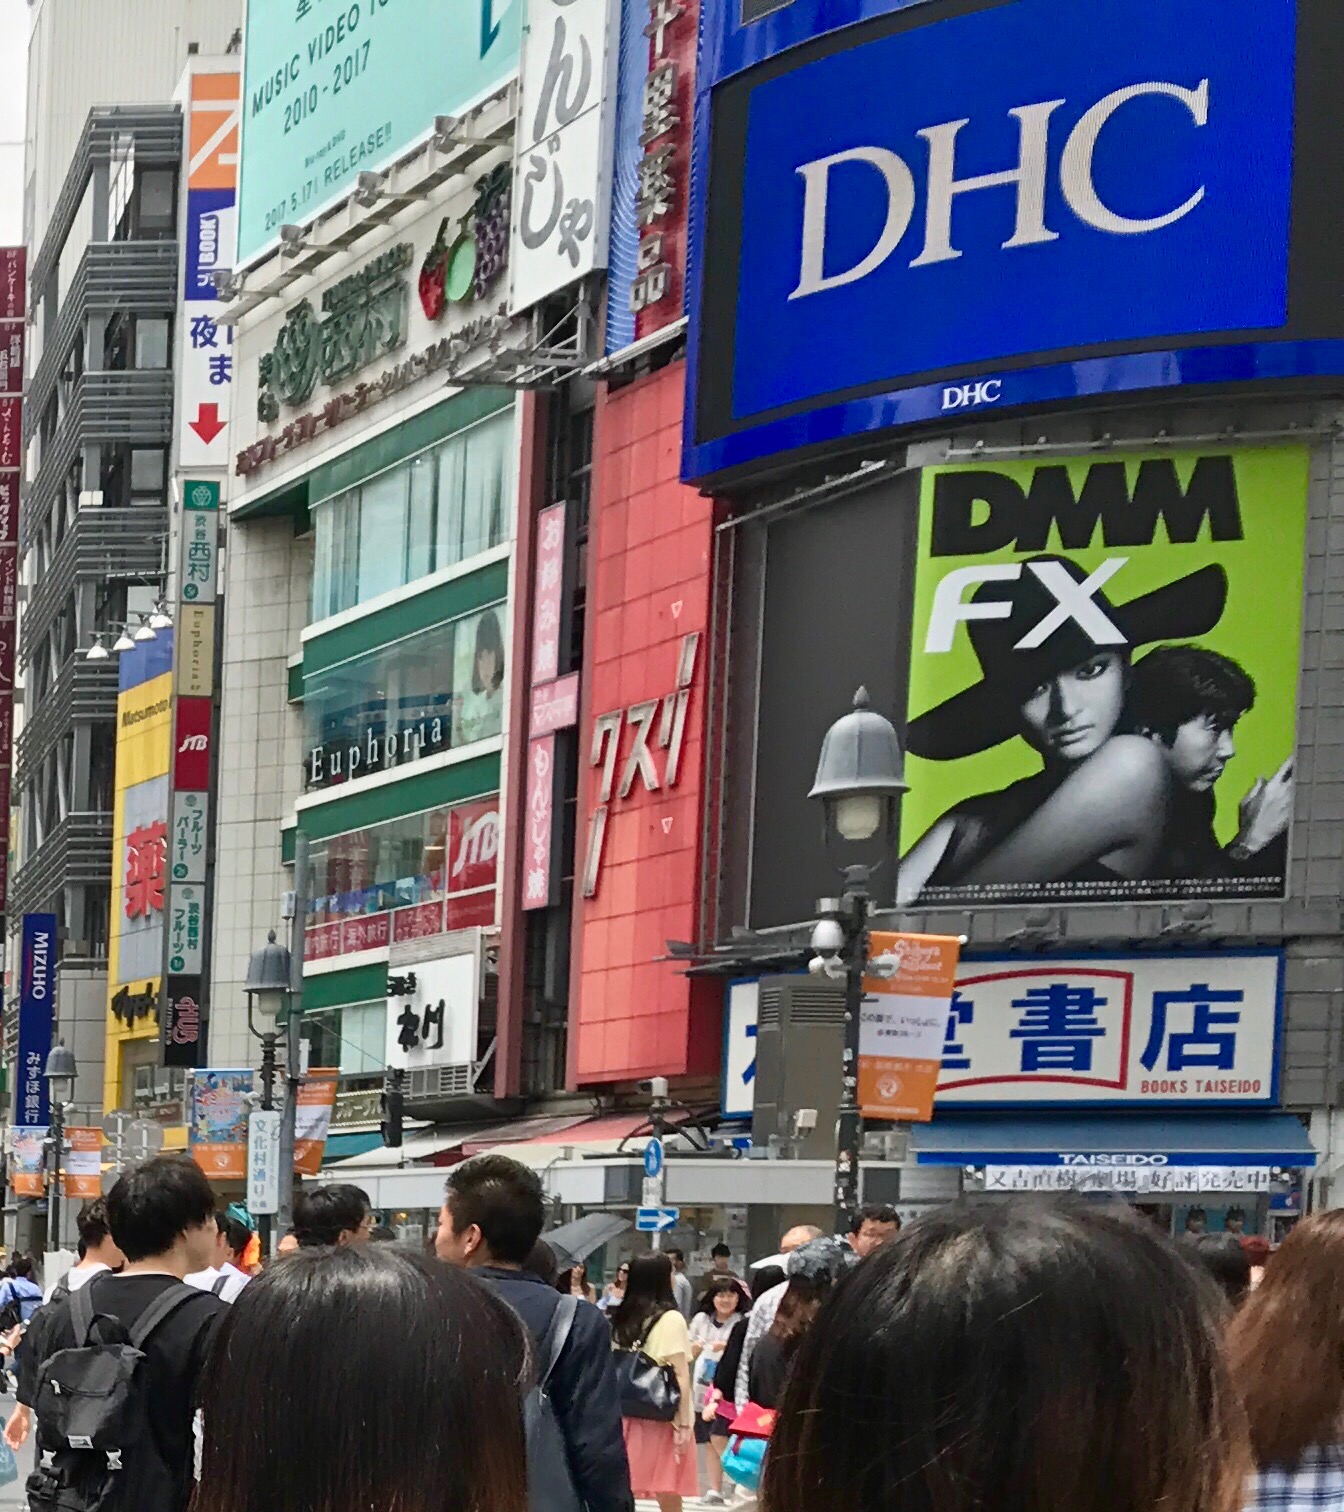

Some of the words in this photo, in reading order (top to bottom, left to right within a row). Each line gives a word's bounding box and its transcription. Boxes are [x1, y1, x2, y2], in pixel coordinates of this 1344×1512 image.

[252, 54, 300, 117] MUSIC
[308, 3, 360, 65] VIDEO
[284, 84, 317, 134] 2010
[333, 39, 371, 96] 2017
[520, 0, 593, 268] んじゃ
[787, 78, 1209, 300] DHC
[942, 380, 1002, 410] DHC
[930, 455, 1244, 557] DMM
[923, 557, 1130, 653] FX
[178, 734, 209, 753] JTB
[309, 710, 443, 784] Euphoria
[589, 688, 691, 803] クスリ
[177, 816, 189, 861] パーラー
[191, 810, 203, 855] フルーツ
[452, 810, 499, 877] JTB
[32, 932, 49, 1000] MIZUHO
[173, 909, 185, 953] フルーツ
[173, 996, 199, 1045] HUB
[25, 1052, 41, 1124] みずほ銀行
[1141, 1080, 1188, 1094] BOOKS
[1195, 1080, 1262, 1094] TAISEIDO
[253, 1119, 268, 1198] 文化村通り
[1059, 1154, 1169, 1165] TAISEIDO
